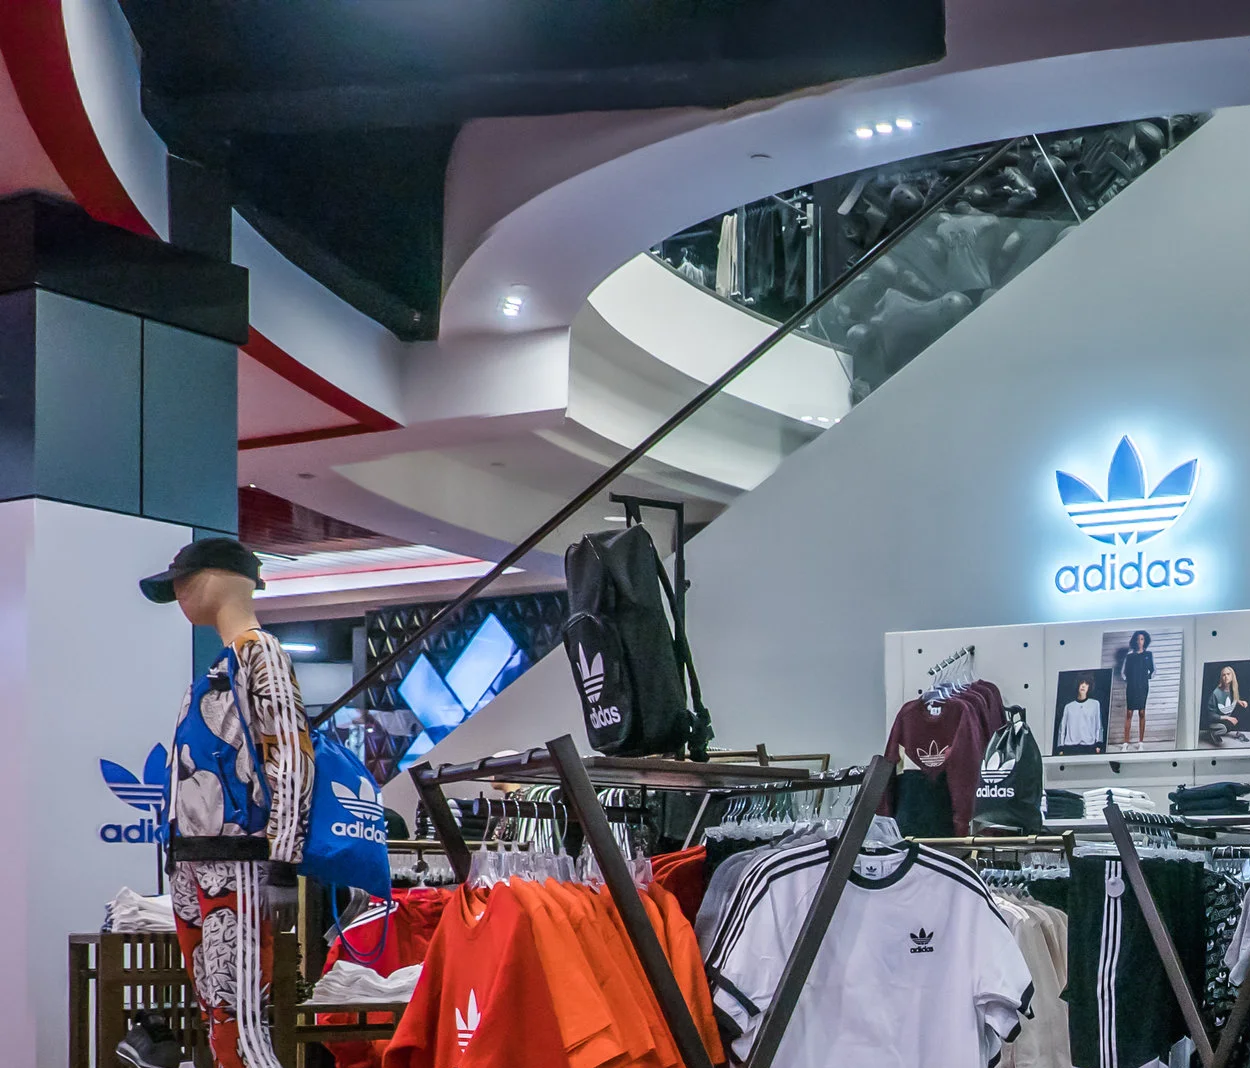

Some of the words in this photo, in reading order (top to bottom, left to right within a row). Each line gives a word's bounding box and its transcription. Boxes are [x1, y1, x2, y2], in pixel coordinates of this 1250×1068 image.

[1054, 551, 1196, 594] adidas
[976, 784, 1015, 798] adidas
[100, 818, 161, 843] adi
